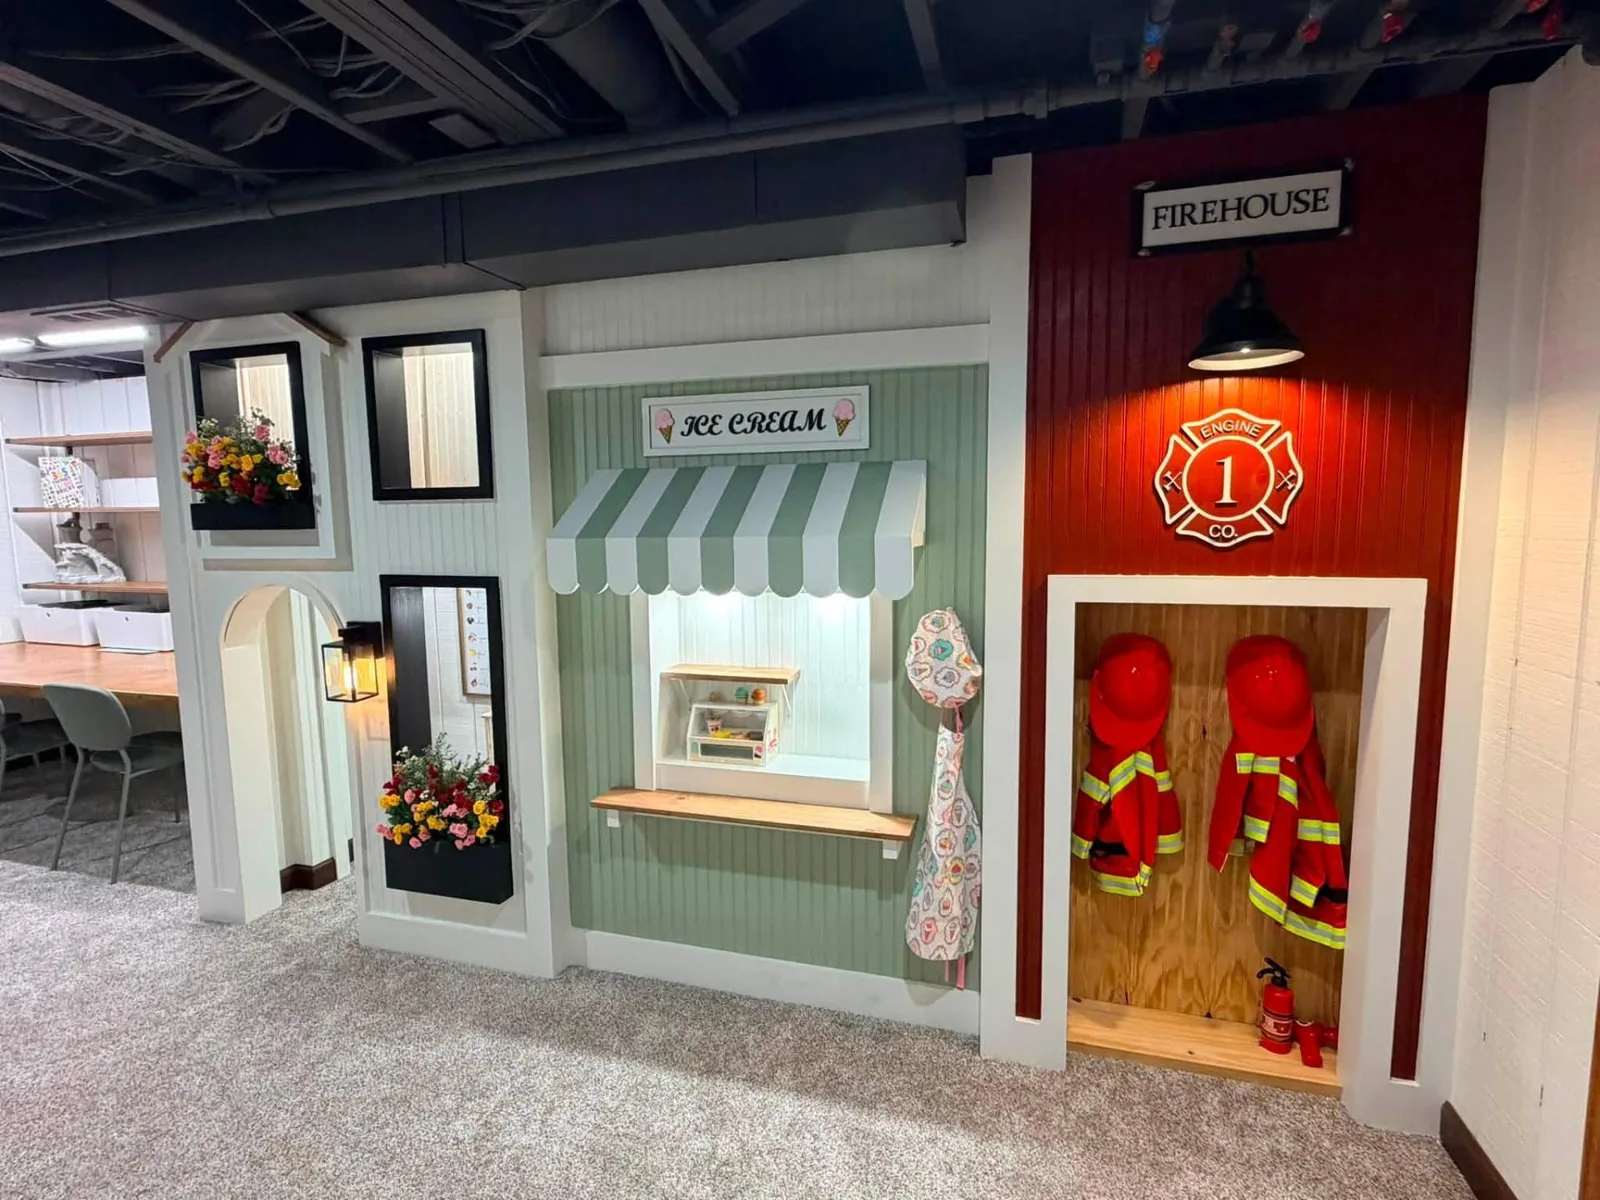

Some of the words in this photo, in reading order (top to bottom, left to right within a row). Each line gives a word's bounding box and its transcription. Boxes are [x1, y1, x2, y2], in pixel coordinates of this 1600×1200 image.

[1151, 188, 1330, 230] FIREHOUSE
[680, 414, 723, 437] ICE
[728, 408, 827, 434] CREAM
[1201, 419, 1262, 438] ENGINE
[1215, 455, 1238, 504] 1
[1208, 524, 1239, 538] CO.
